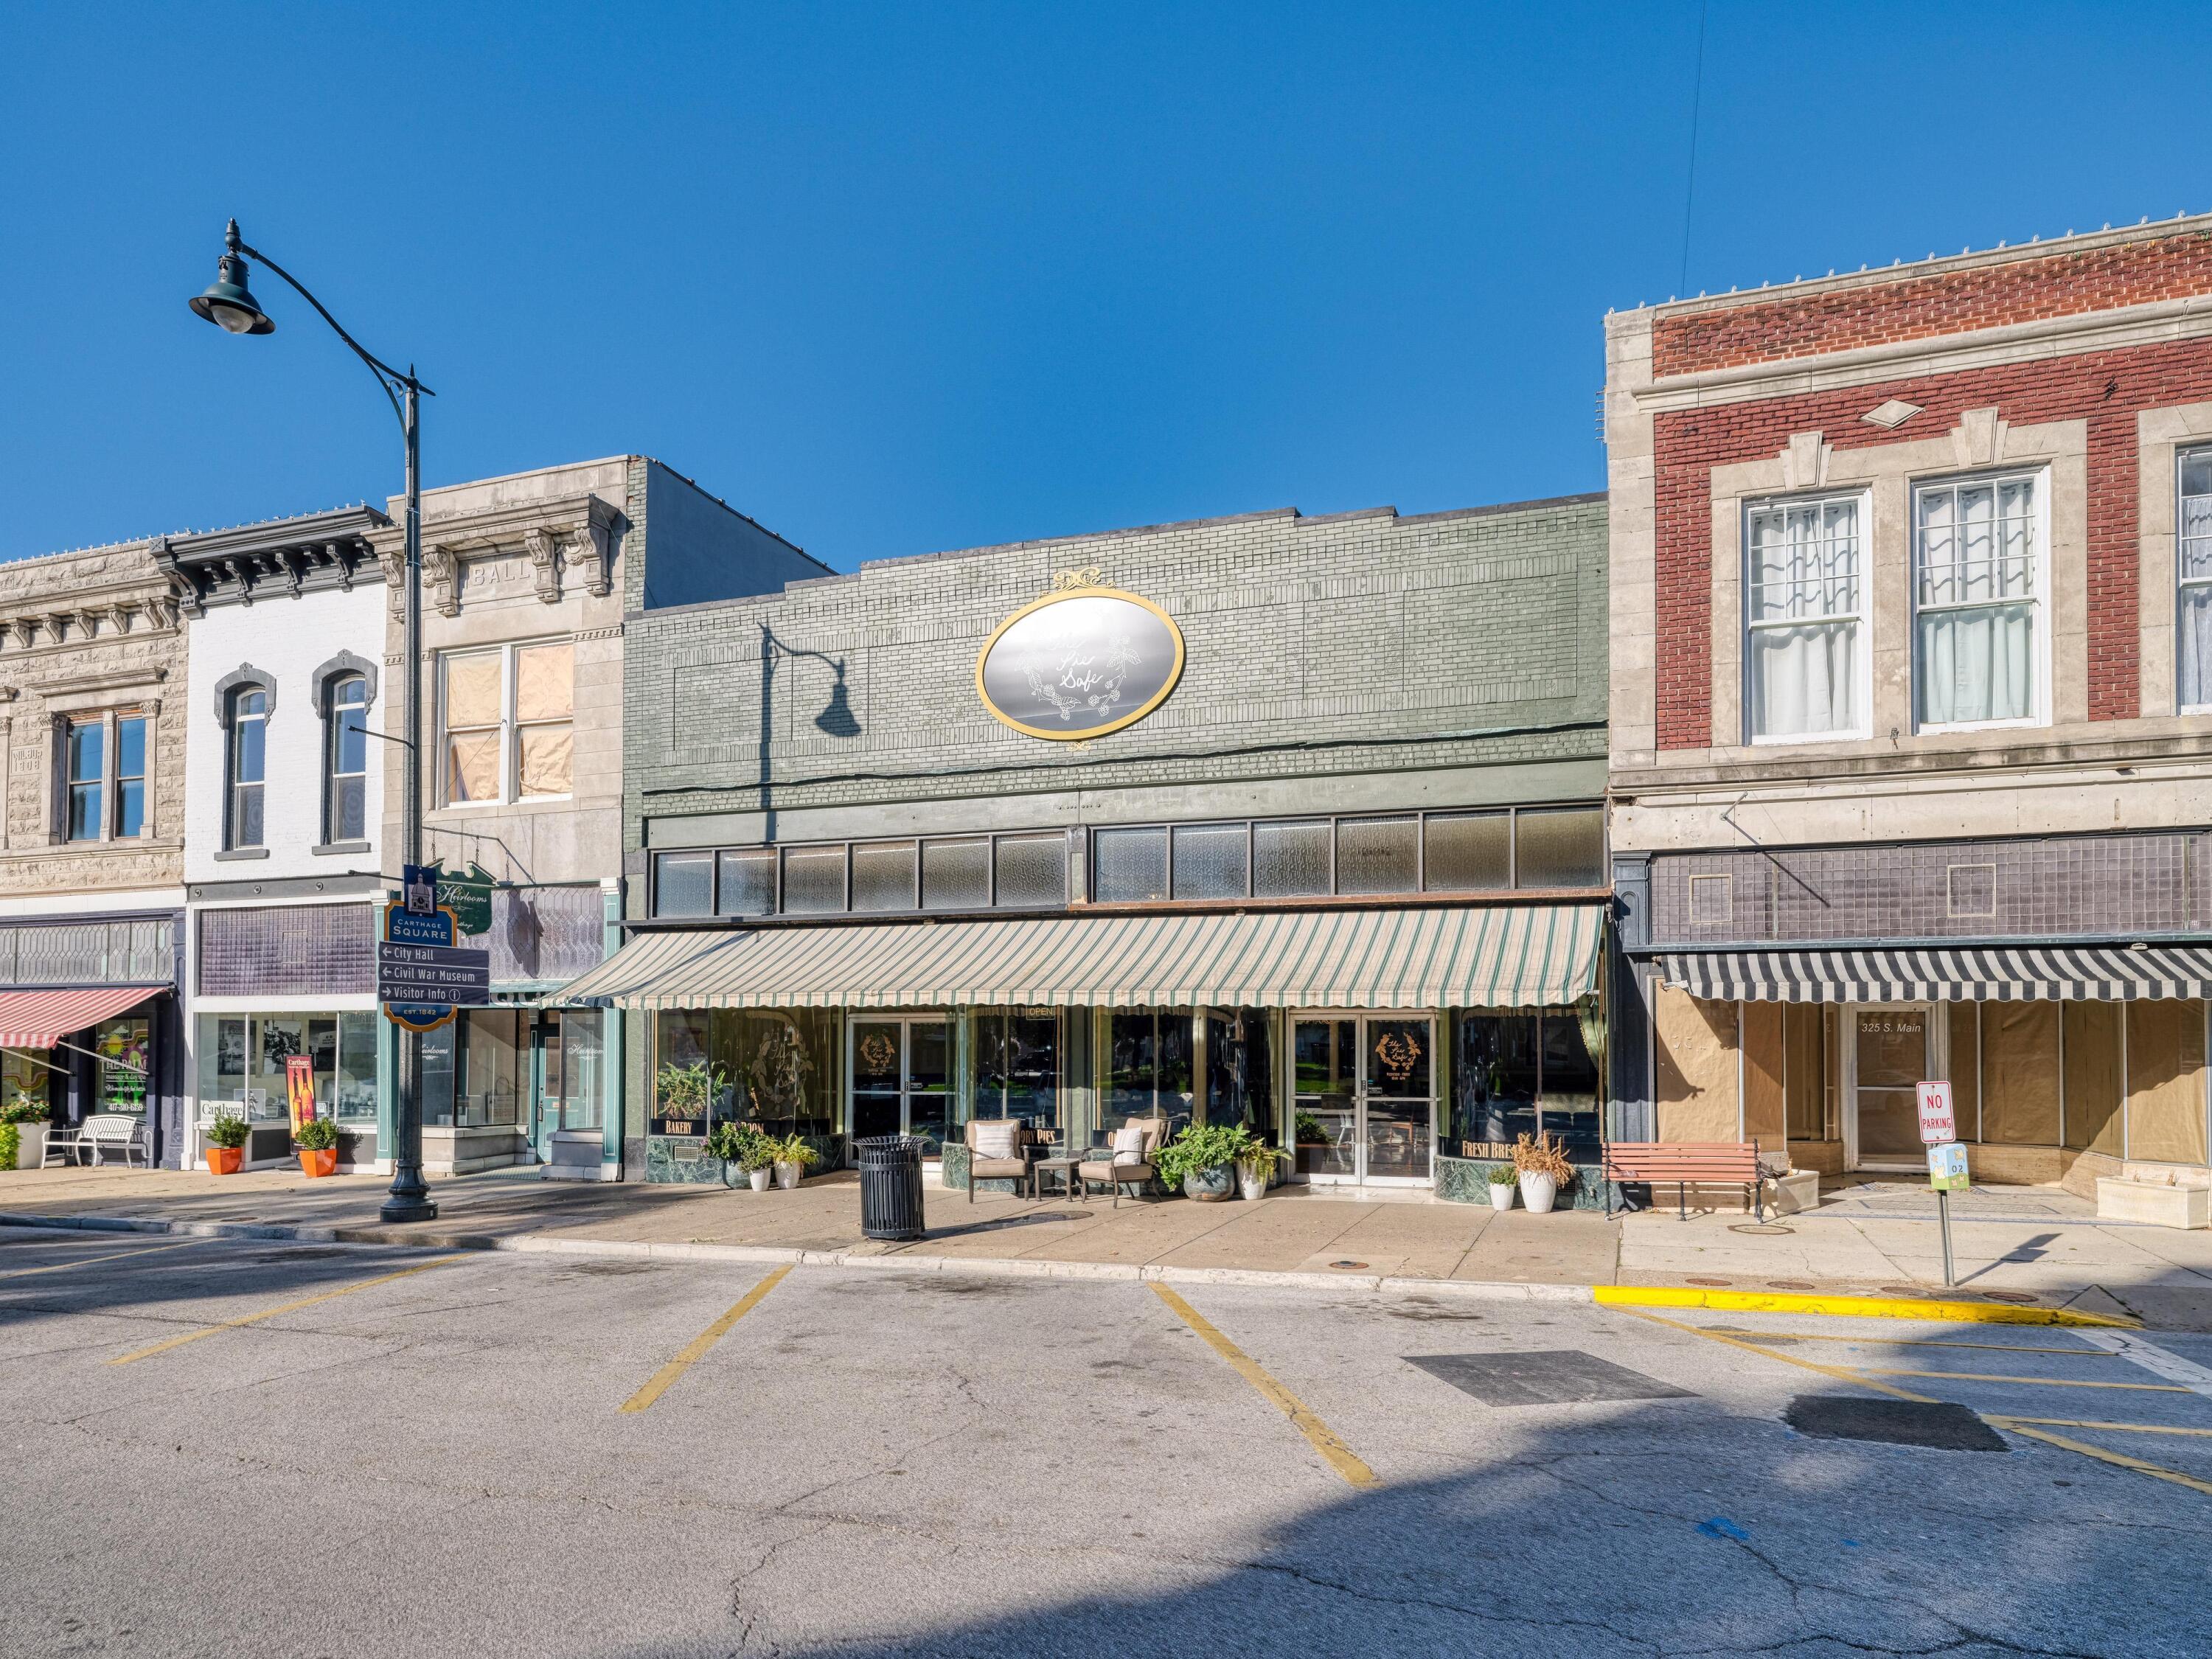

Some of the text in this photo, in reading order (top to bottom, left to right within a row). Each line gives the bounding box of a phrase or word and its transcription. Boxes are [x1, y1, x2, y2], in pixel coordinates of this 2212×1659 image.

[473, 560, 530, 586] BALL
[1056, 650, 1096, 672] Pie
[1059, 667, 1104, 692] Safe
[13, 748, 43, 761] WILBUR
[437, 885, 487, 903] Heirlooms
[393, 926, 448, 939] SQUARE
[394, 947, 434, 961] City Hall
[394, 967, 476, 982] Civil War Museum
[394, 987, 425, 999] Visitor
[428, 989, 446, 1000] Info
[1029, 1007, 1053, 1015] OPEN
[1862, 1023, 1921, 1032] 325 S. Main
[567, 1043, 603, 1055] Heirloom
[288, 1058, 310, 1066] Carthage
[1927, 1095, 1943, 1109] NO
[202, 1103, 243, 1117] Carthage
[666, 1120, 692, 1134] BAKERY
[1922, 1117, 1952, 1130] PARKING
[1020, 1129, 1056, 1144] ORY PIES
[1462, 1140, 1489, 1158] FRESH
[1952, 1165, 1964, 1173] 02
